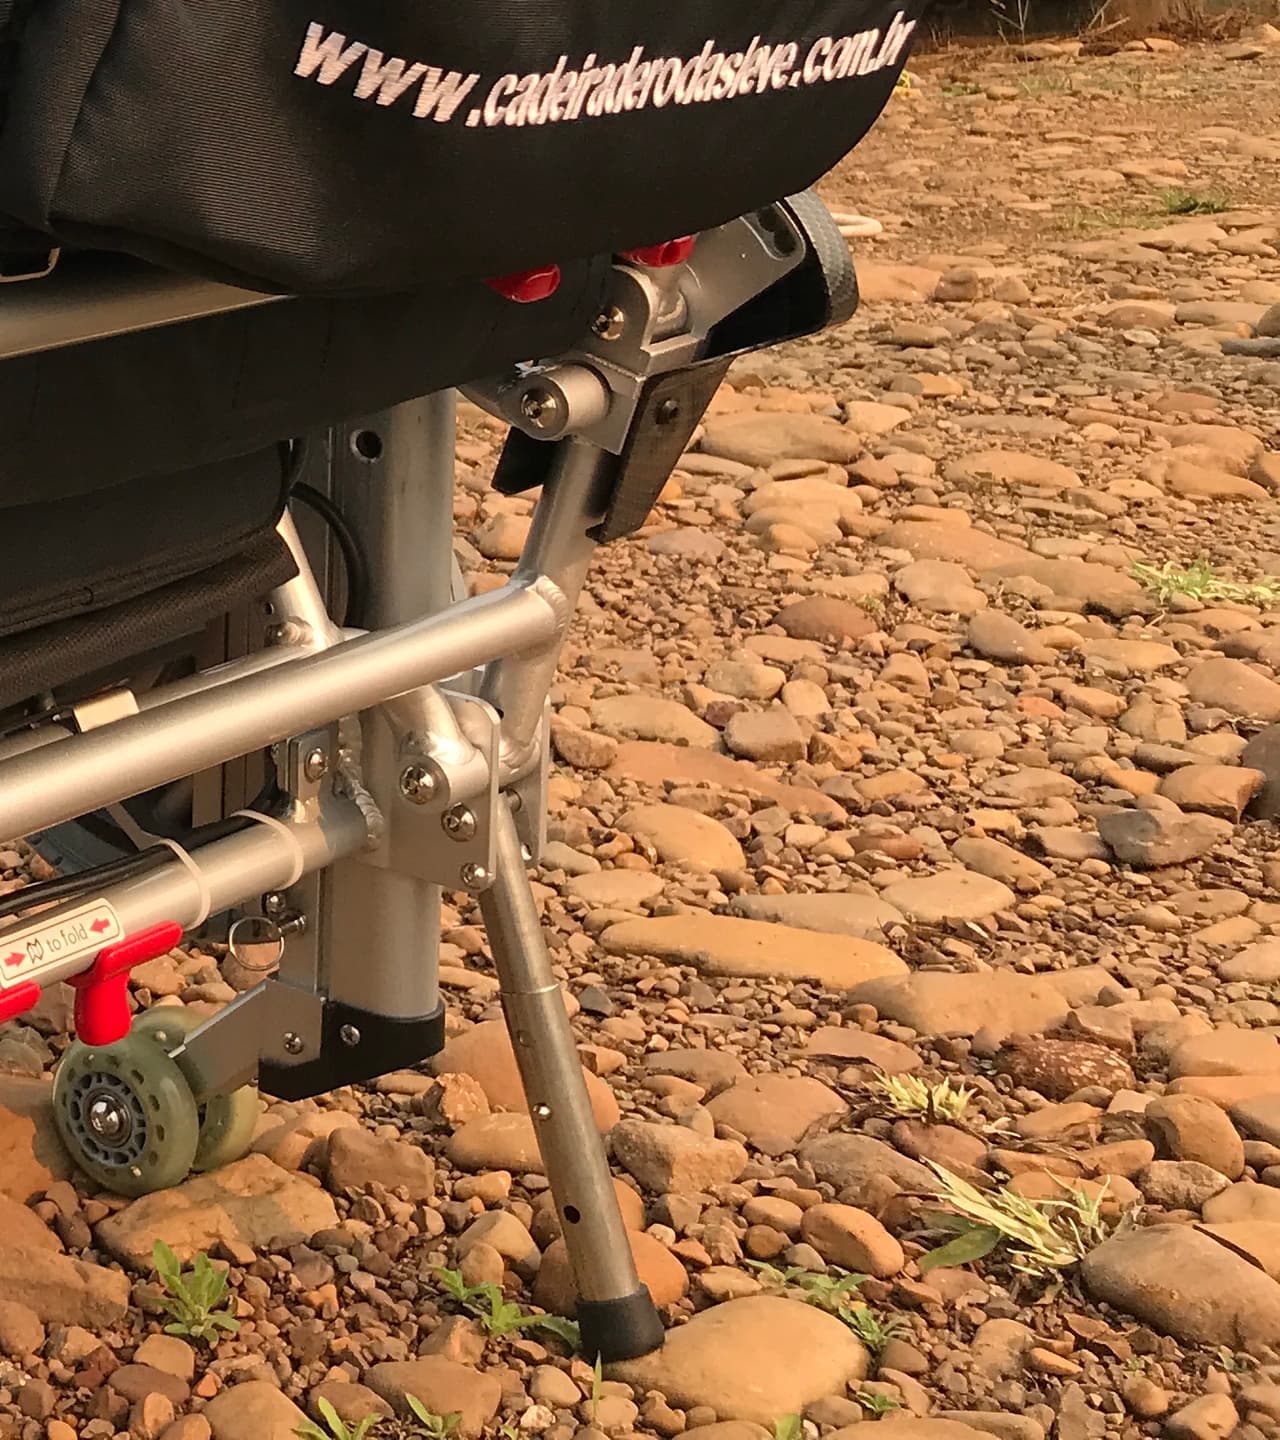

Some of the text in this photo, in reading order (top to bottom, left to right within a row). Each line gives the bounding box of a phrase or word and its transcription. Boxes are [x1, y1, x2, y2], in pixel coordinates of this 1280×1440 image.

[292, 10, 917, 128] www.cadeiraderodasleve.com.br
[46, 922, 89, 953] to fold
